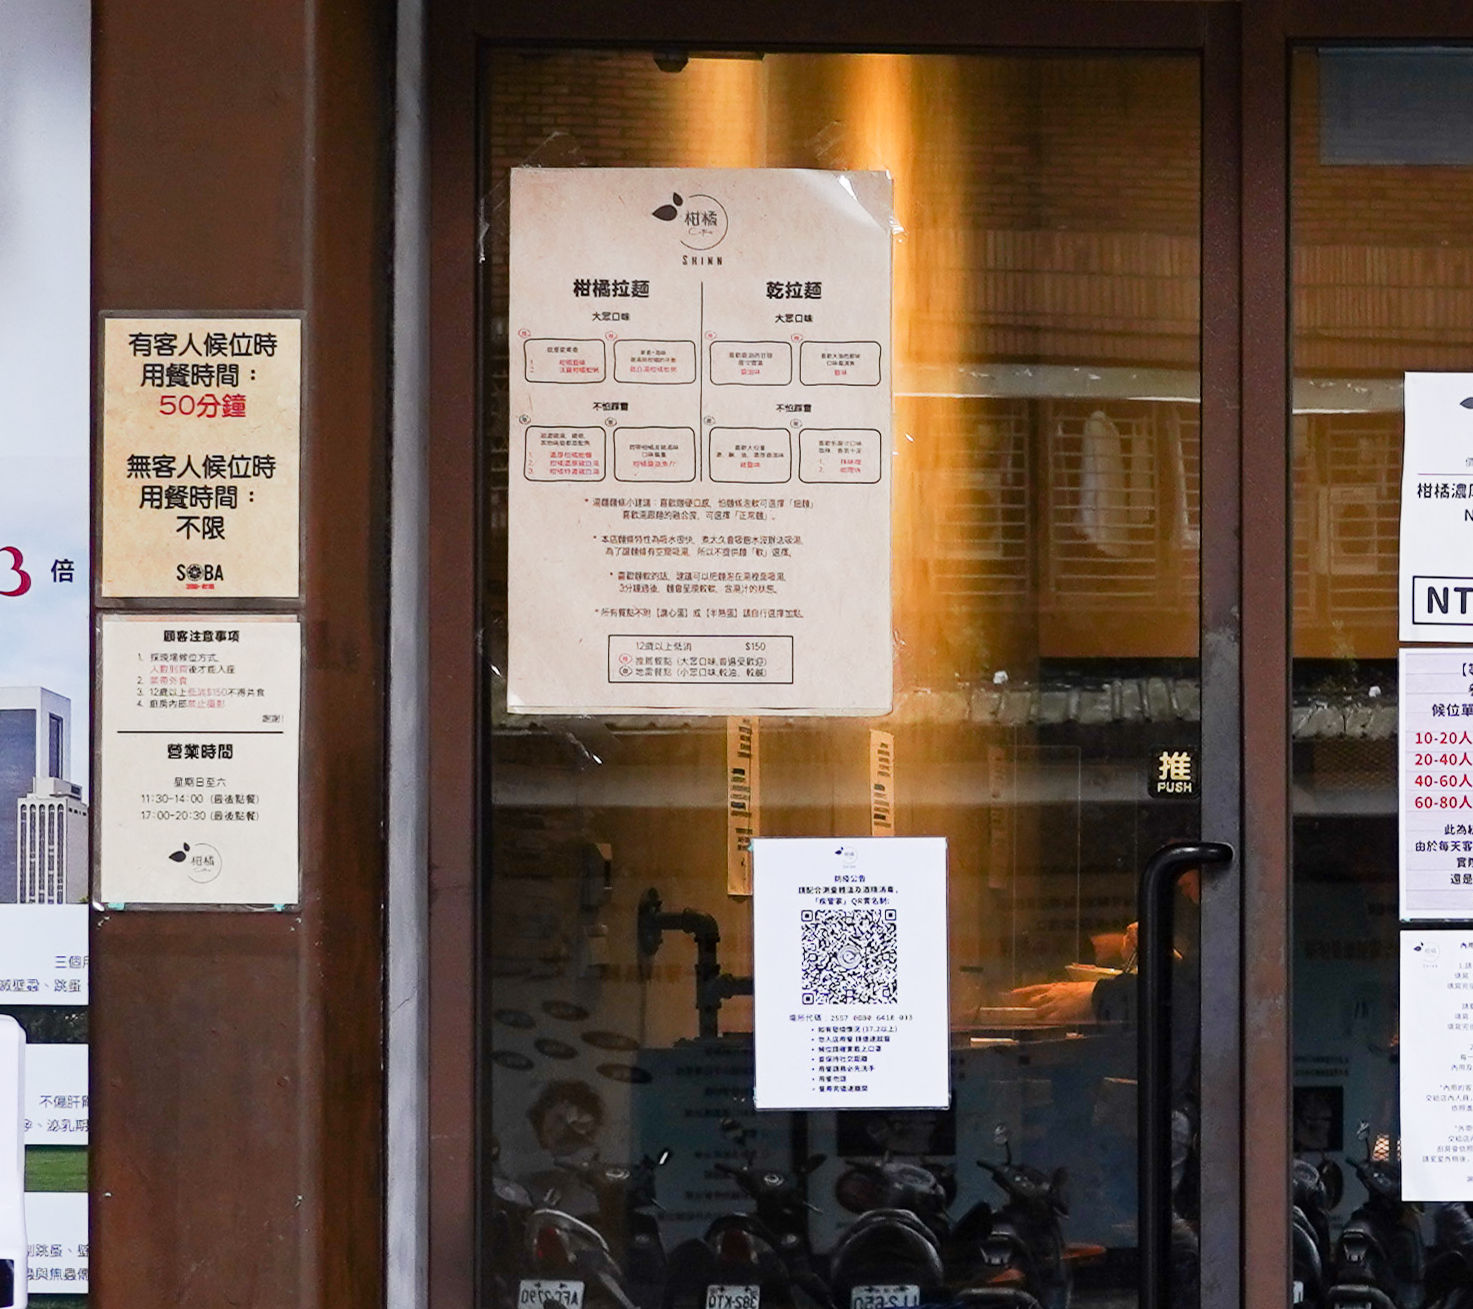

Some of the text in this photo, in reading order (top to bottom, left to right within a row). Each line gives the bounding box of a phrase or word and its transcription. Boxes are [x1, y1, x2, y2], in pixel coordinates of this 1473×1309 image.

[128, 332, 277, 357] 有客人候位時
[141, 363, 257, 388] 用餐時間：
[159, 394, 247, 419] 50分鐘
[126, 455, 276, 479] 無客人候位時
[139, 486, 254, 510] 用餐時間：
[176, 516, 226, 540] 不限
[176, 564, 224, 582] SOBA
[1415, 732, 1473, 745] 10-20人
[167, 743, 234, 760] 營業時間
[1415, 753, 1473, 766] 20-40人
[1159, 751, 1191, 780] 推
[1157, 782, 1192, 793] PUSH
[1415, 774, 1473, 787] 40-60人
[141, 793, 203, 804] 11:30-14:00
[1415, 796, 1473, 809] 60-80人
[141, 810, 206, 821] 17:00-20:30
